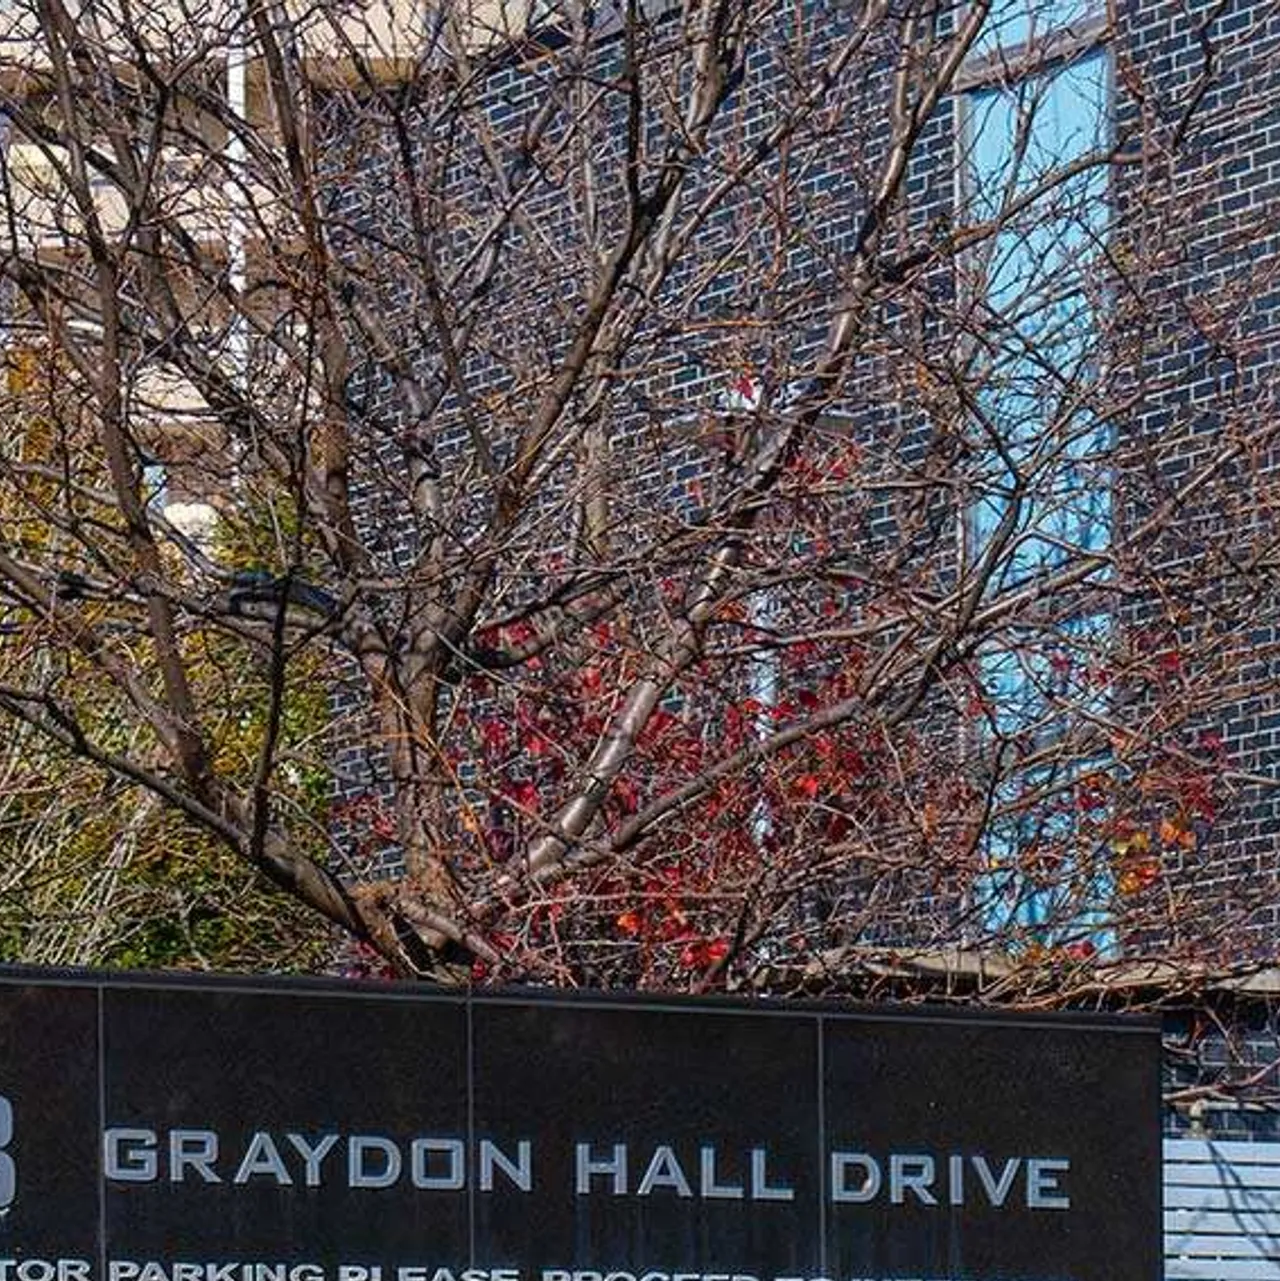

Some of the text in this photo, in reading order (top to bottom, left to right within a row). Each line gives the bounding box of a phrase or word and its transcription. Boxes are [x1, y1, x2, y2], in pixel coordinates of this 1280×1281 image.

[102, 1127, 533, 1192] GRAYDON
[575, 1142, 794, 1200] HALL
[830, 1152, 1072, 1209] DRIVE
